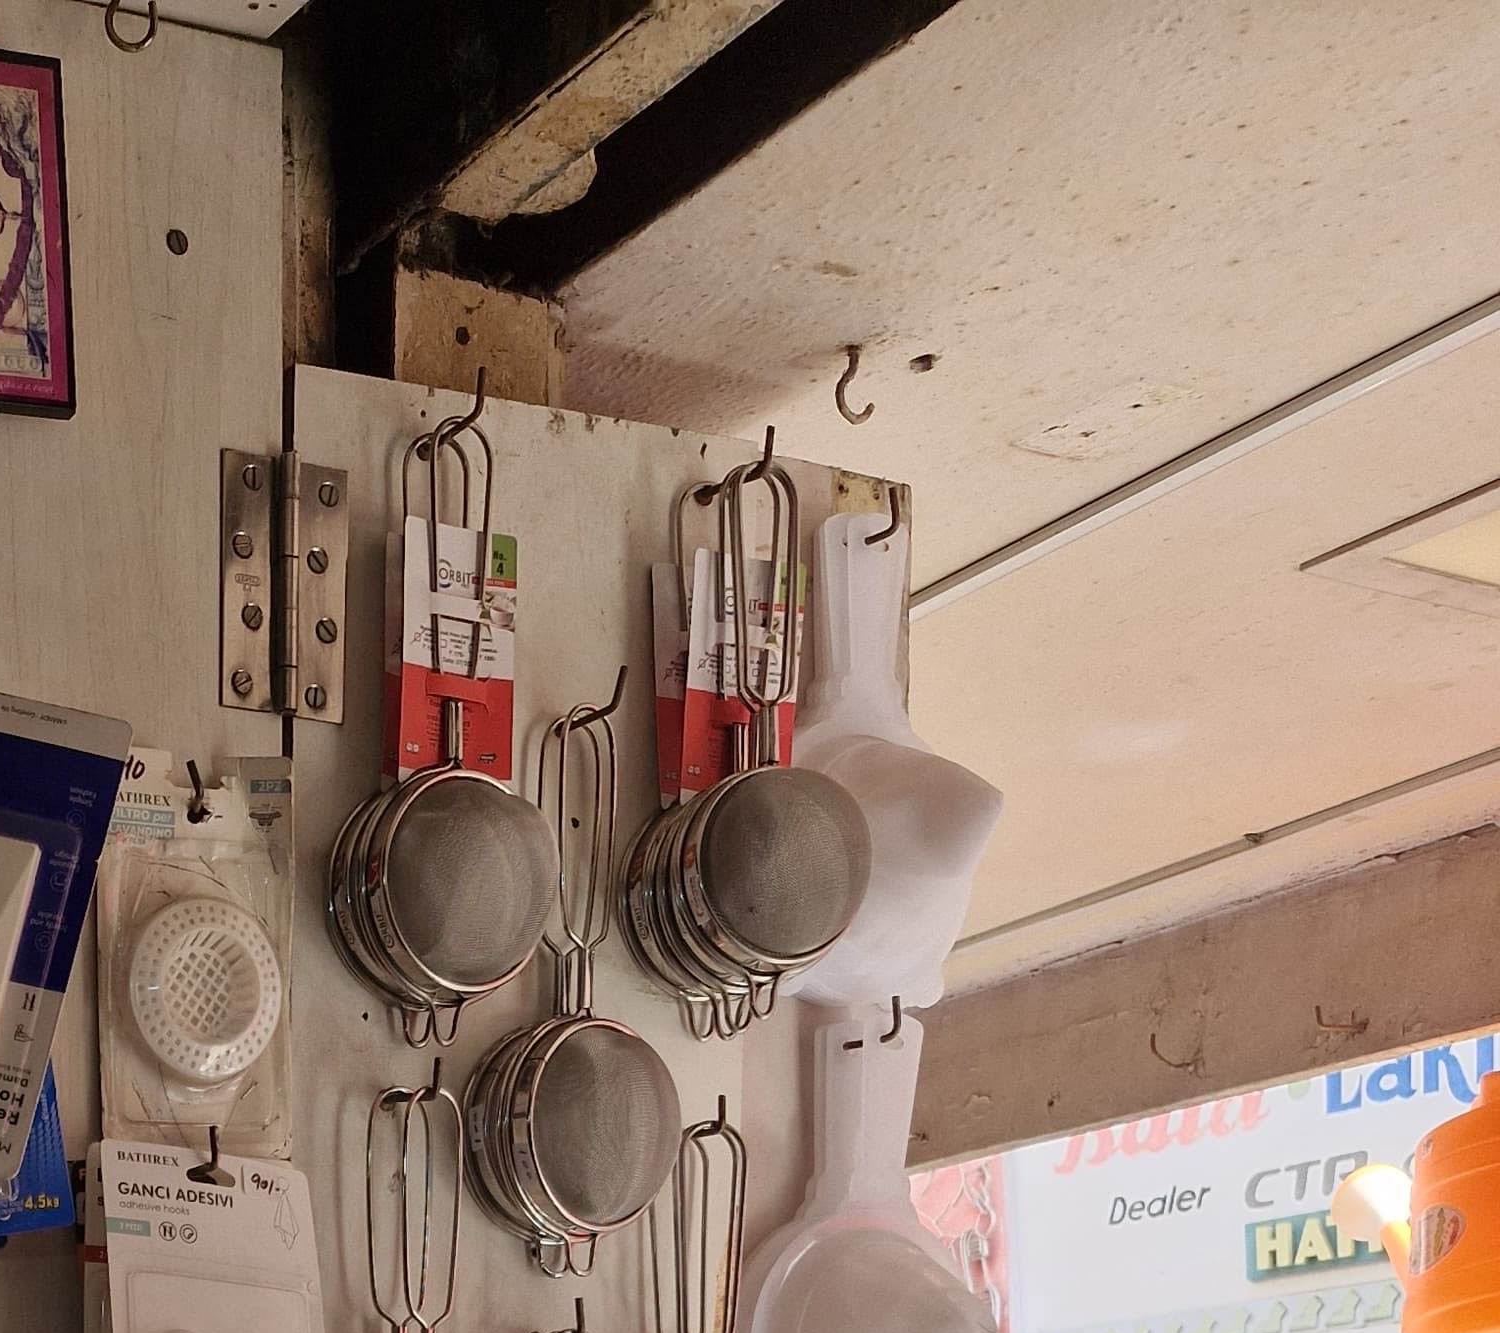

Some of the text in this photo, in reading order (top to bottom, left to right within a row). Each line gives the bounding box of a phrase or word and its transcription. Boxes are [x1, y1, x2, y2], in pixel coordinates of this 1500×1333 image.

[116, 1150, 180, 1167] BATHREX
[24, 1195, 60, 1210] 4.5kg
[117, 1182, 234, 1209] GANCI ADESIVI
[119, 1200, 190, 1217] adhesive hooks
[1108, 1185, 1212, 1227] Dealer
